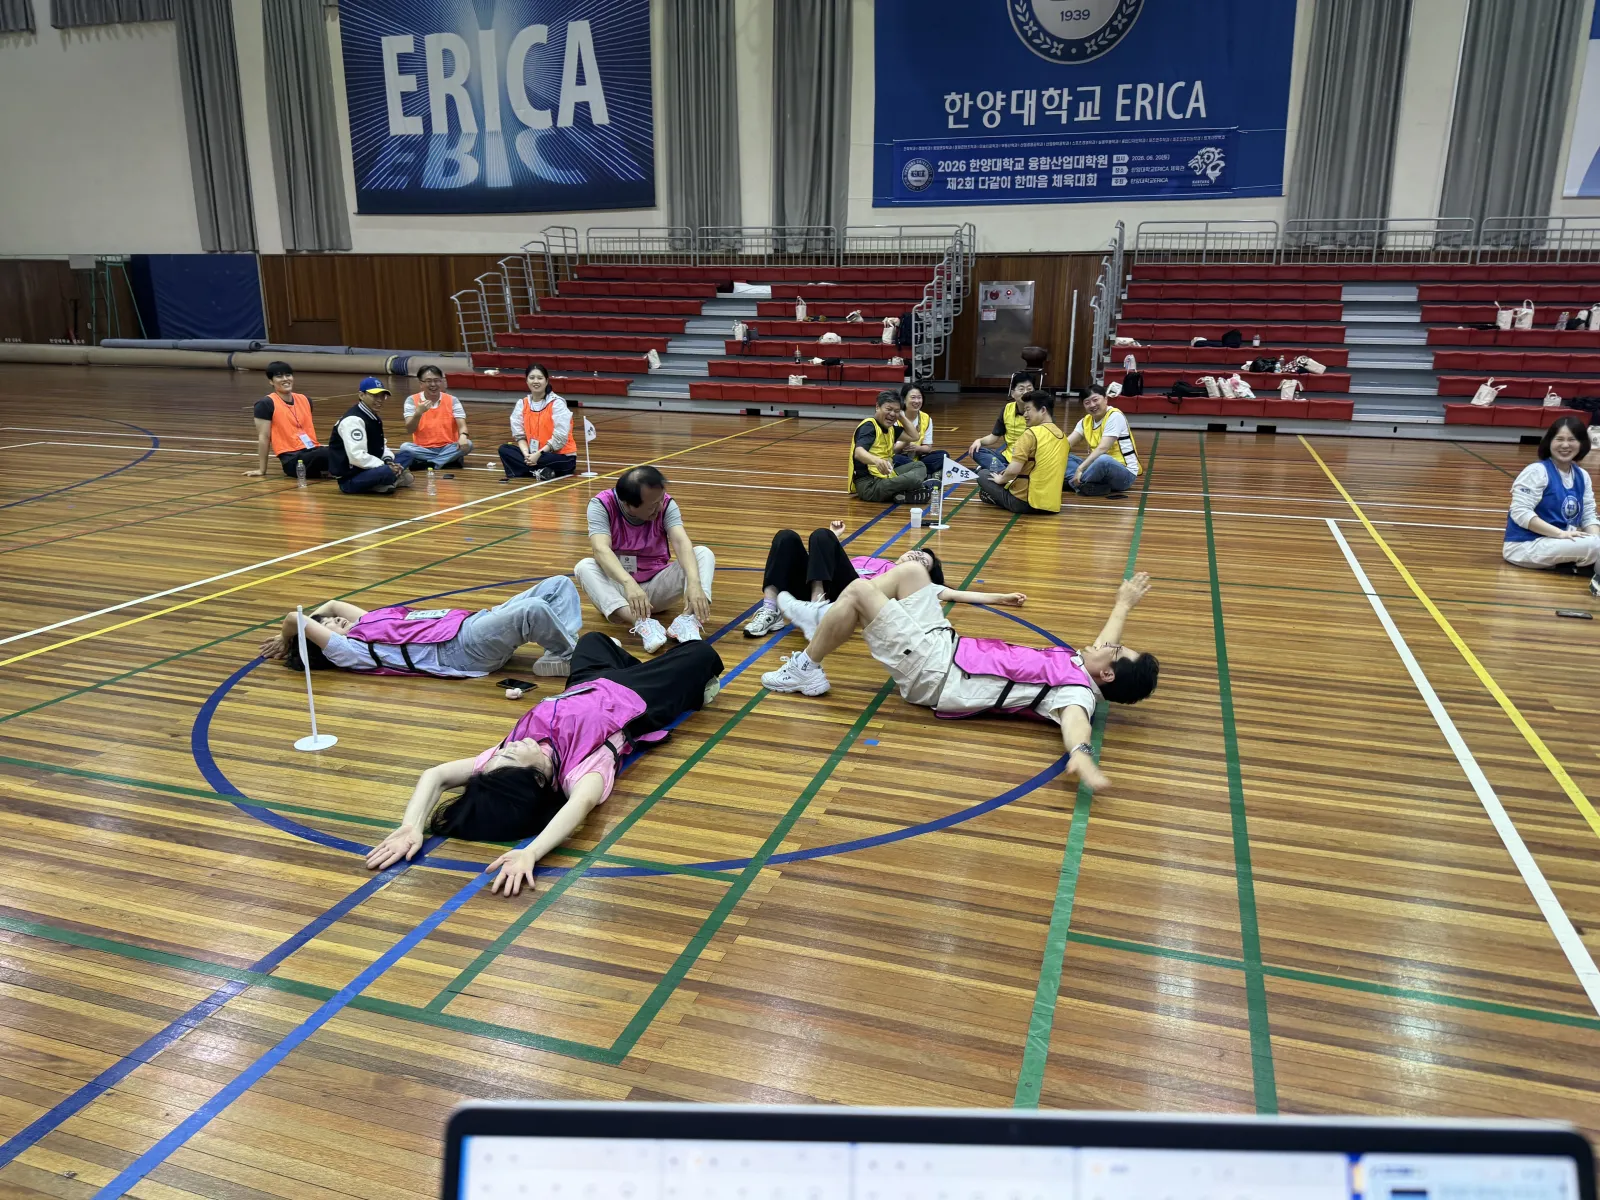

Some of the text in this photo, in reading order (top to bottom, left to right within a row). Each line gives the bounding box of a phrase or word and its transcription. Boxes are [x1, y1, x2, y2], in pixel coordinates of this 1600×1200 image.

[1060, 9, 1091, 22] 1939
[381, 20, 610, 136] ERICA
[944, 80, 1207, 129] 한양대학교 ERICA
[937, 154, 1108, 173] 2026 한양대학교 융합산업대학원
[946, 173, 1097, 191] 제2회 다같이 한마음 체육대회
[960, 470, 970, 479] 5조
